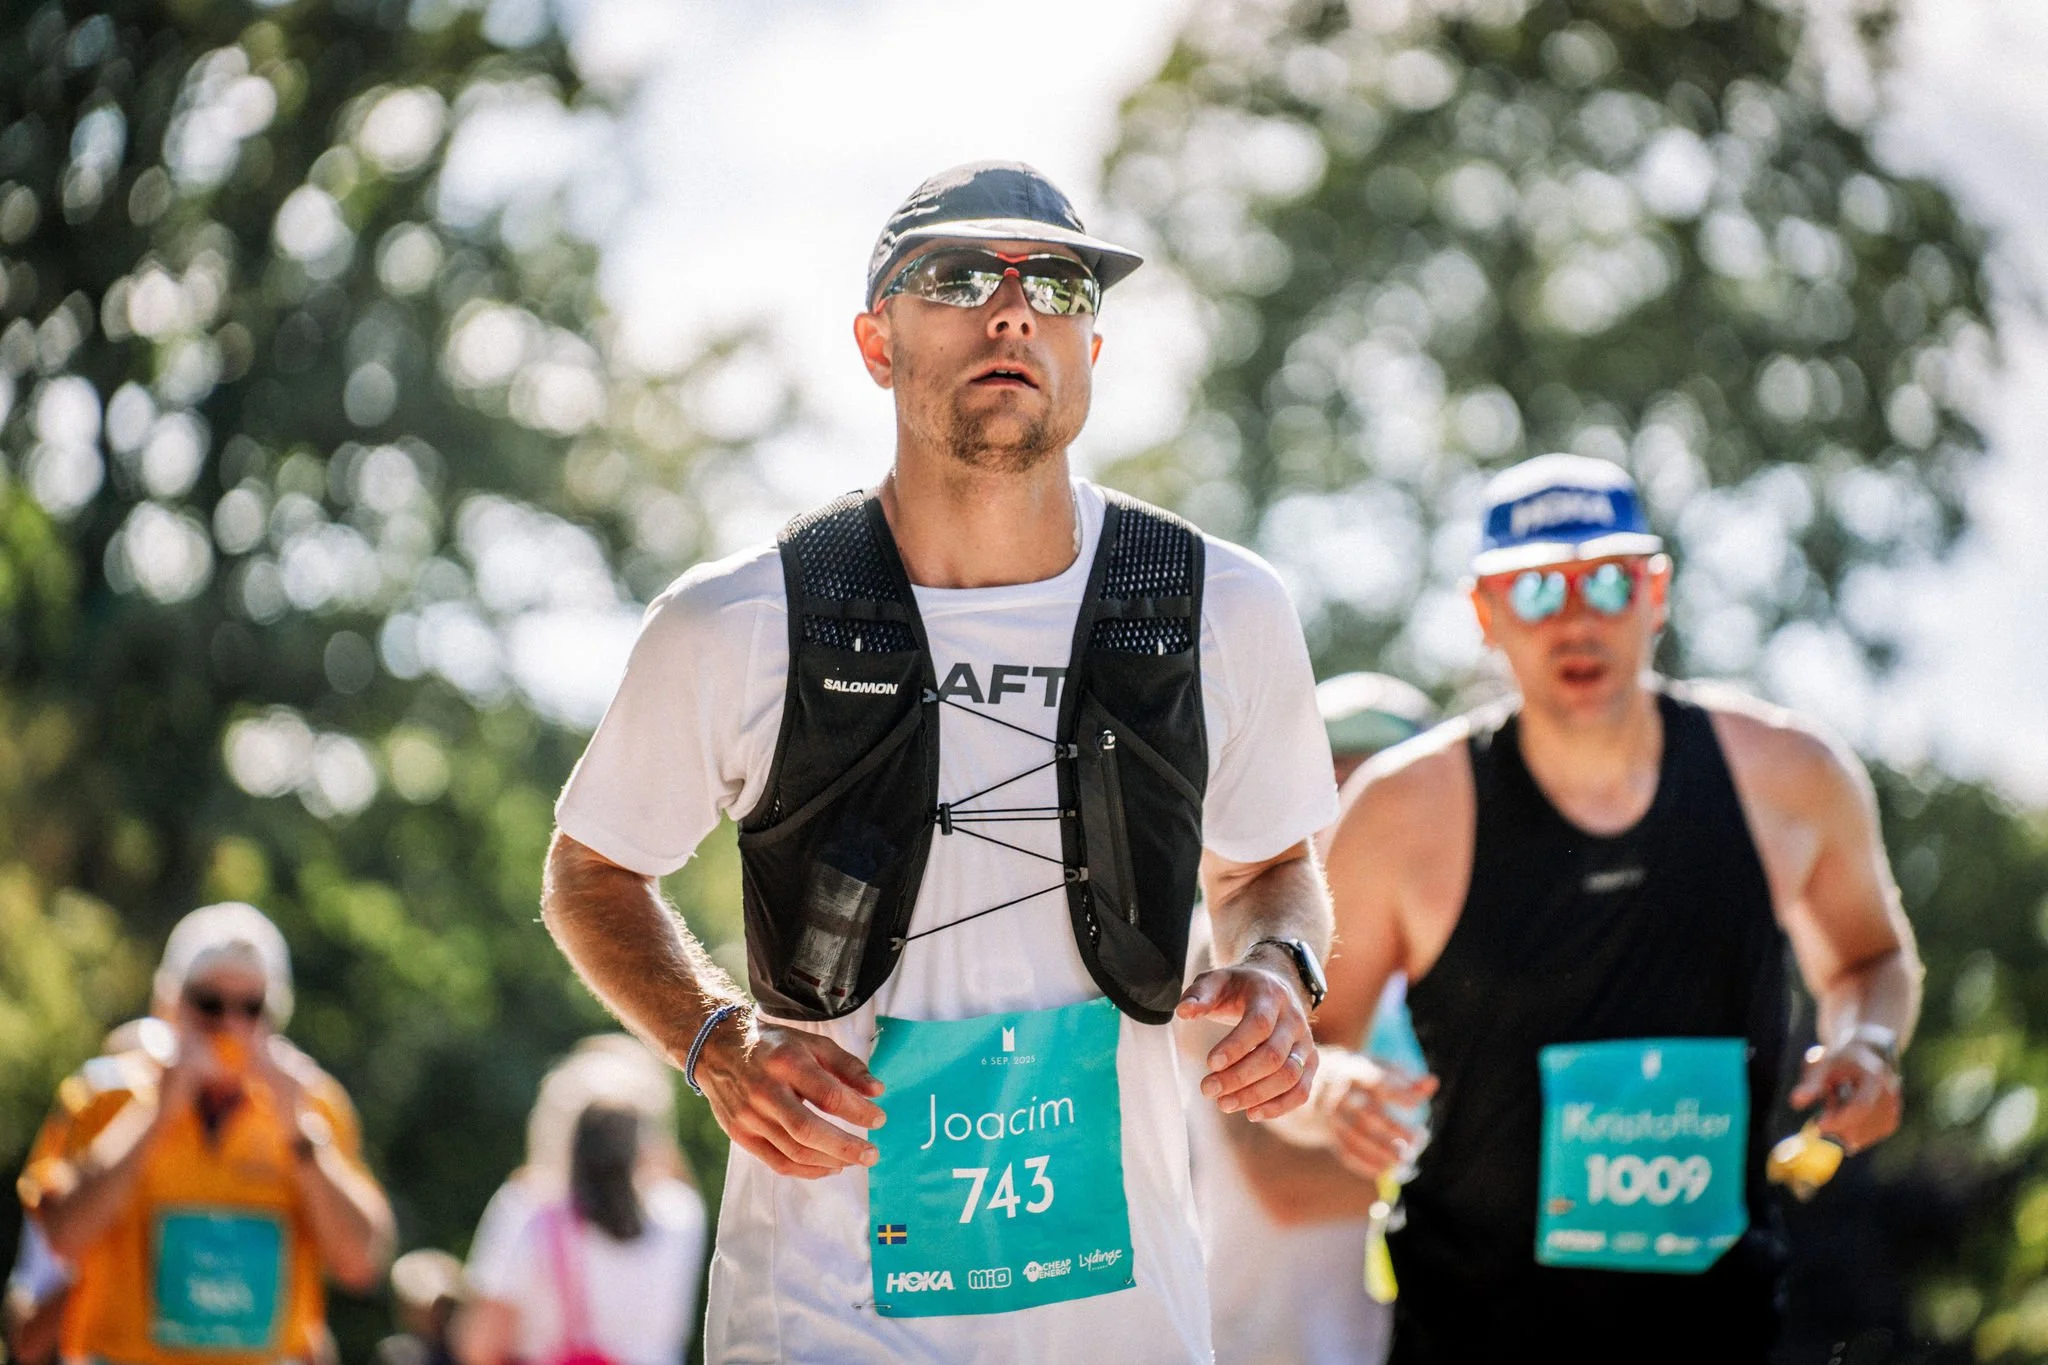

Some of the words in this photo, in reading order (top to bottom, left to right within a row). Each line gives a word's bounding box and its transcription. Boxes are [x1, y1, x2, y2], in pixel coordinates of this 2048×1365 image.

[823, 678, 898, 695] SALOMON
[981, 1056, 987, 1065] 6
[990, 1056, 1009, 1065] SEP
[1013, 1055, 1036, 1065] 2025
[920, 1094, 1075, 1150] Joacim
[1584, 1153, 1712, 1206] 1009
[952, 1155, 1055, 1224] 743
[1039, 1266, 1071, 1279] ENERGY
[1042, 1258, 1071, 1271] CHEAP
[886, 1271, 954, 1293] HOKA
